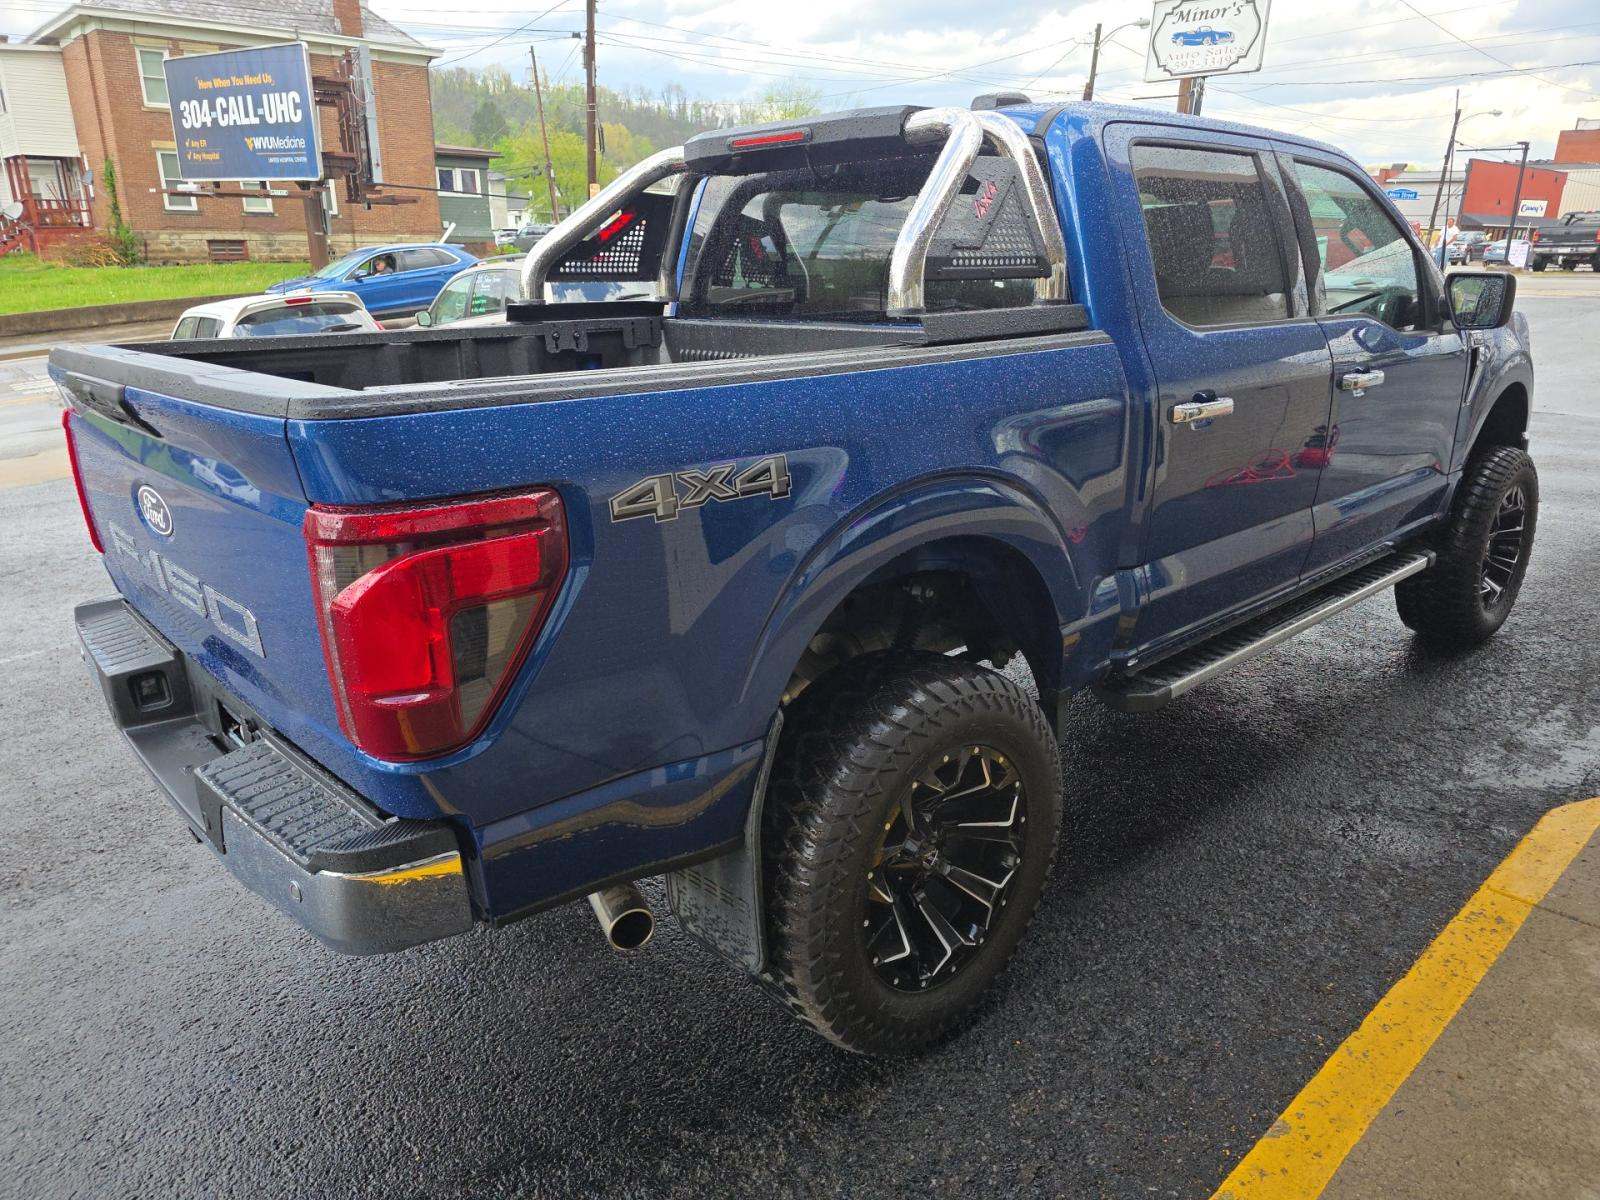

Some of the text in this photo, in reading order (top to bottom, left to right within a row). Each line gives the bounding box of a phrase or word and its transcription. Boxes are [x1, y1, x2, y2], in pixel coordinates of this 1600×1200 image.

[1172, 2, 1242, 24] Minor's
[1168, 46, 1246, 61] Auto Sales
[213, 77, 231, 88] When
[231, 75, 244, 86] You
[244, 73, 261, 85] Need
[180, 91, 302, 129] 304-CALL-UHC
[142, 490, 166, 529] Ford
